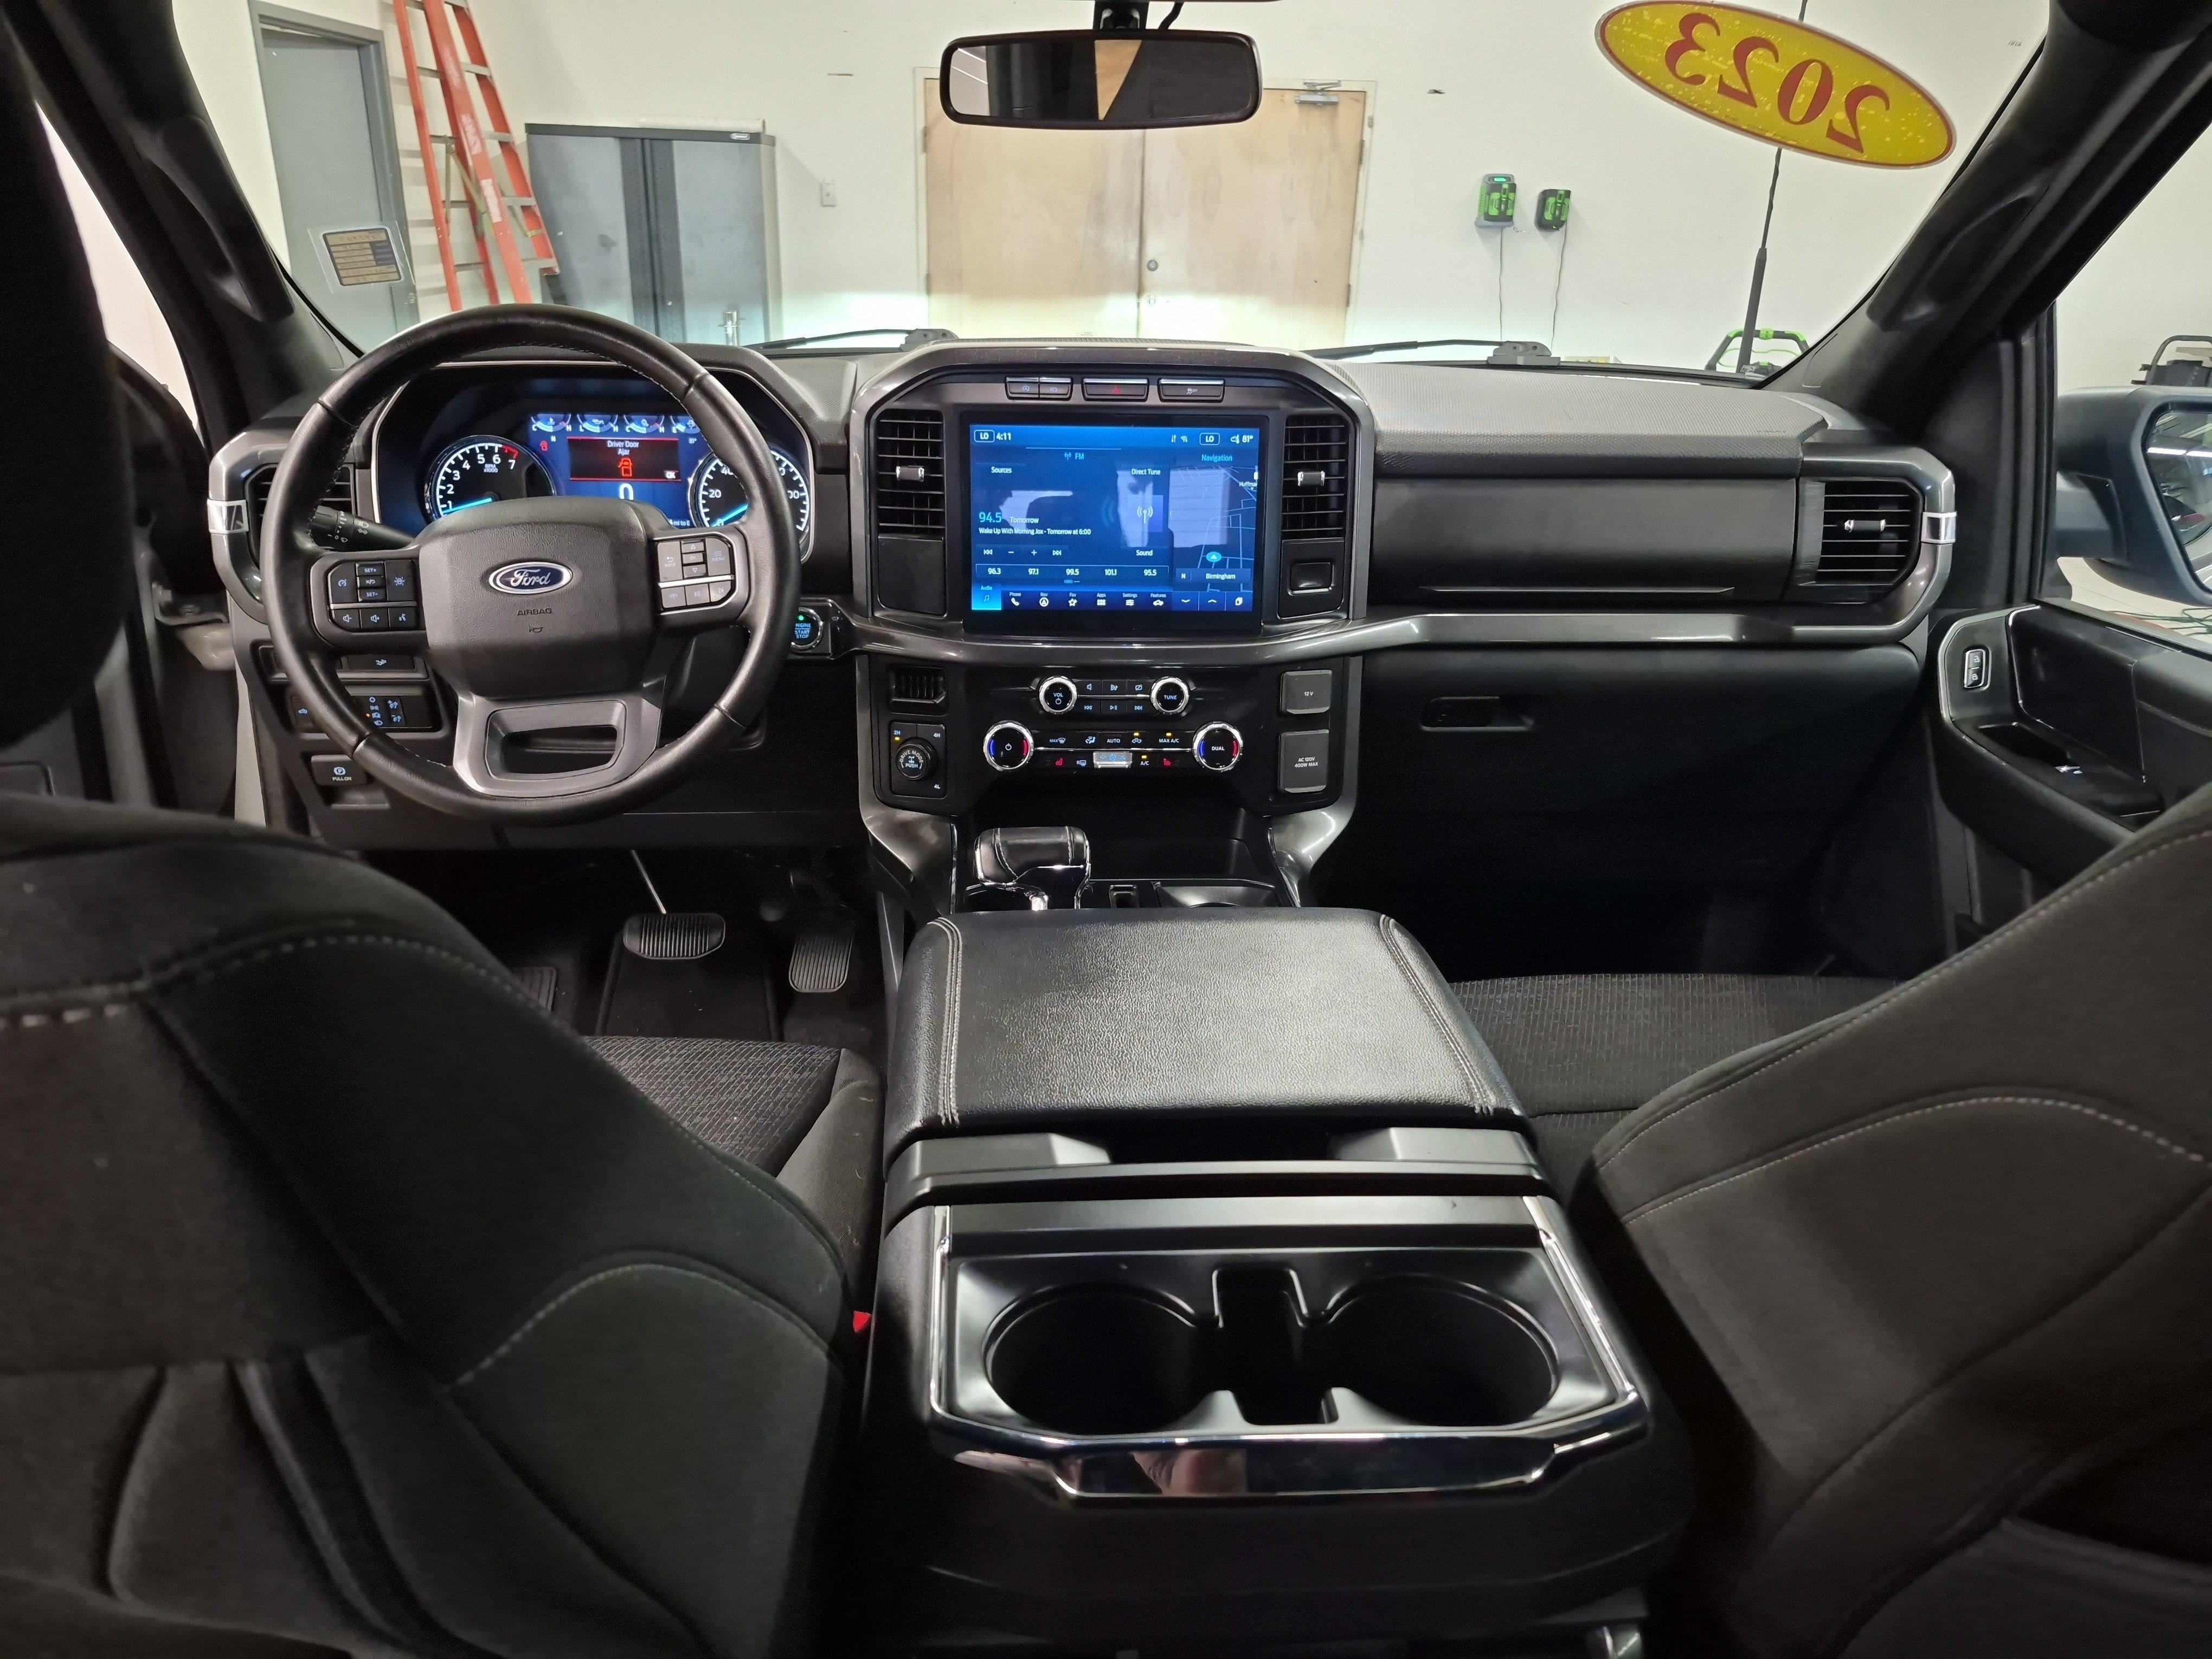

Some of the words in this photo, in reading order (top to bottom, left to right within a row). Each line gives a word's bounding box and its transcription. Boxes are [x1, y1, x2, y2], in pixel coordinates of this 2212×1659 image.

[477, 454, 485, 464] 5
[493, 454, 501, 464] 6
[1201, 454, 1233, 462] Navigation
[462, 460, 471, 470] 4
[508, 460, 516, 470] 7
[452, 470, 461, 481] 3
[447, 484, 454, 494] 2
[709, 489, 722, 498] 20
[447, 500, 453, 510] 1
[979, 511, 1002, 523] 94.5
[510, 569, 551, 587] Ford
[517, 608, 552, 616] AIRBAG
[899, 750, 911, 762] DRIVE
[911, 750, 924, 763] MODE
